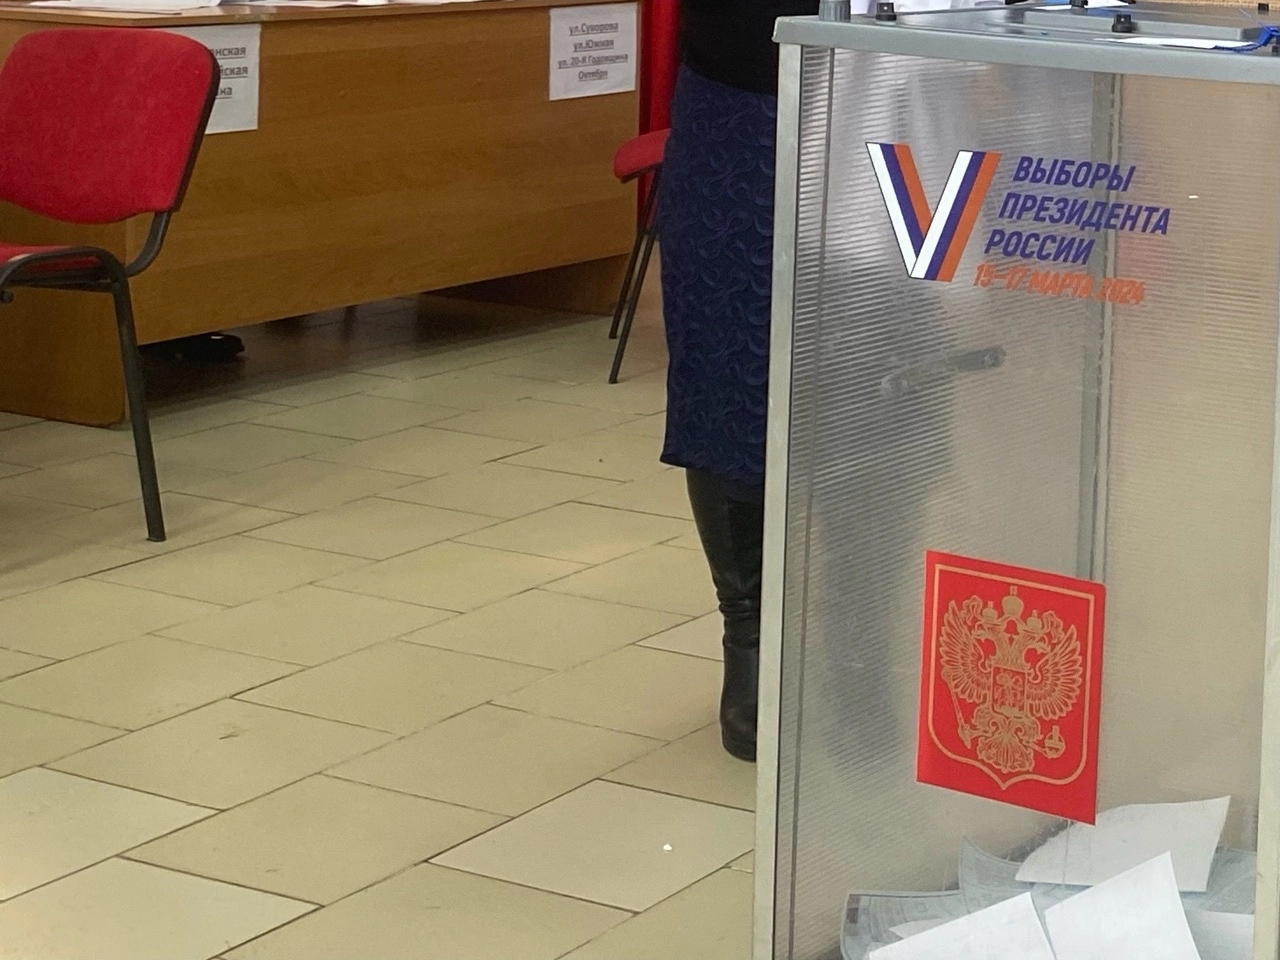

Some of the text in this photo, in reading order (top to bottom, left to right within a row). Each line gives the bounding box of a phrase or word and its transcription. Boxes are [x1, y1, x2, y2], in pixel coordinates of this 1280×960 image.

[1012, 156, 1137, 192] ВЫБОРЫ
[998, 192, 1171, 235] ПРЕЗИДЕНТА
[984, 229, 1096, 265] РОССИИ
[1027, 269, 1095, 300] МАРТА
[1095, 276, 1147, 305] 2024
